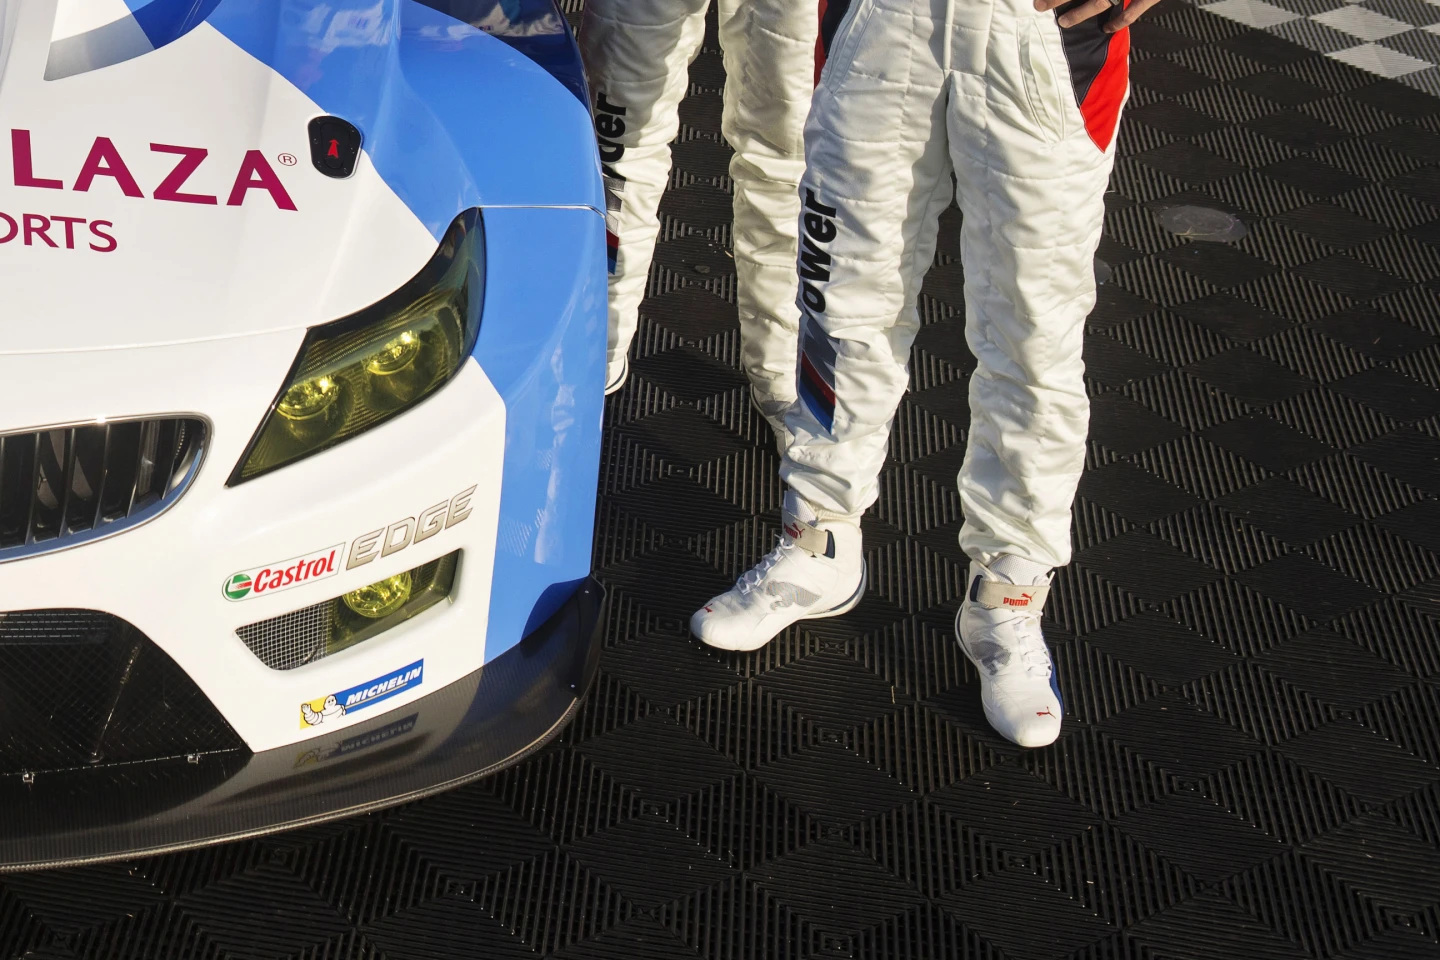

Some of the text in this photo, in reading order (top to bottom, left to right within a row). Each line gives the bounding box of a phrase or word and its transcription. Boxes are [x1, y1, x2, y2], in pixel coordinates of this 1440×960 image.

[800, 186, 838, 314] ower
[253, 483, 478, 593] Castrol EDGE
[1003, 596, 1029, 607] PUMA
[346, 666, 422, 706] MICHELIN
